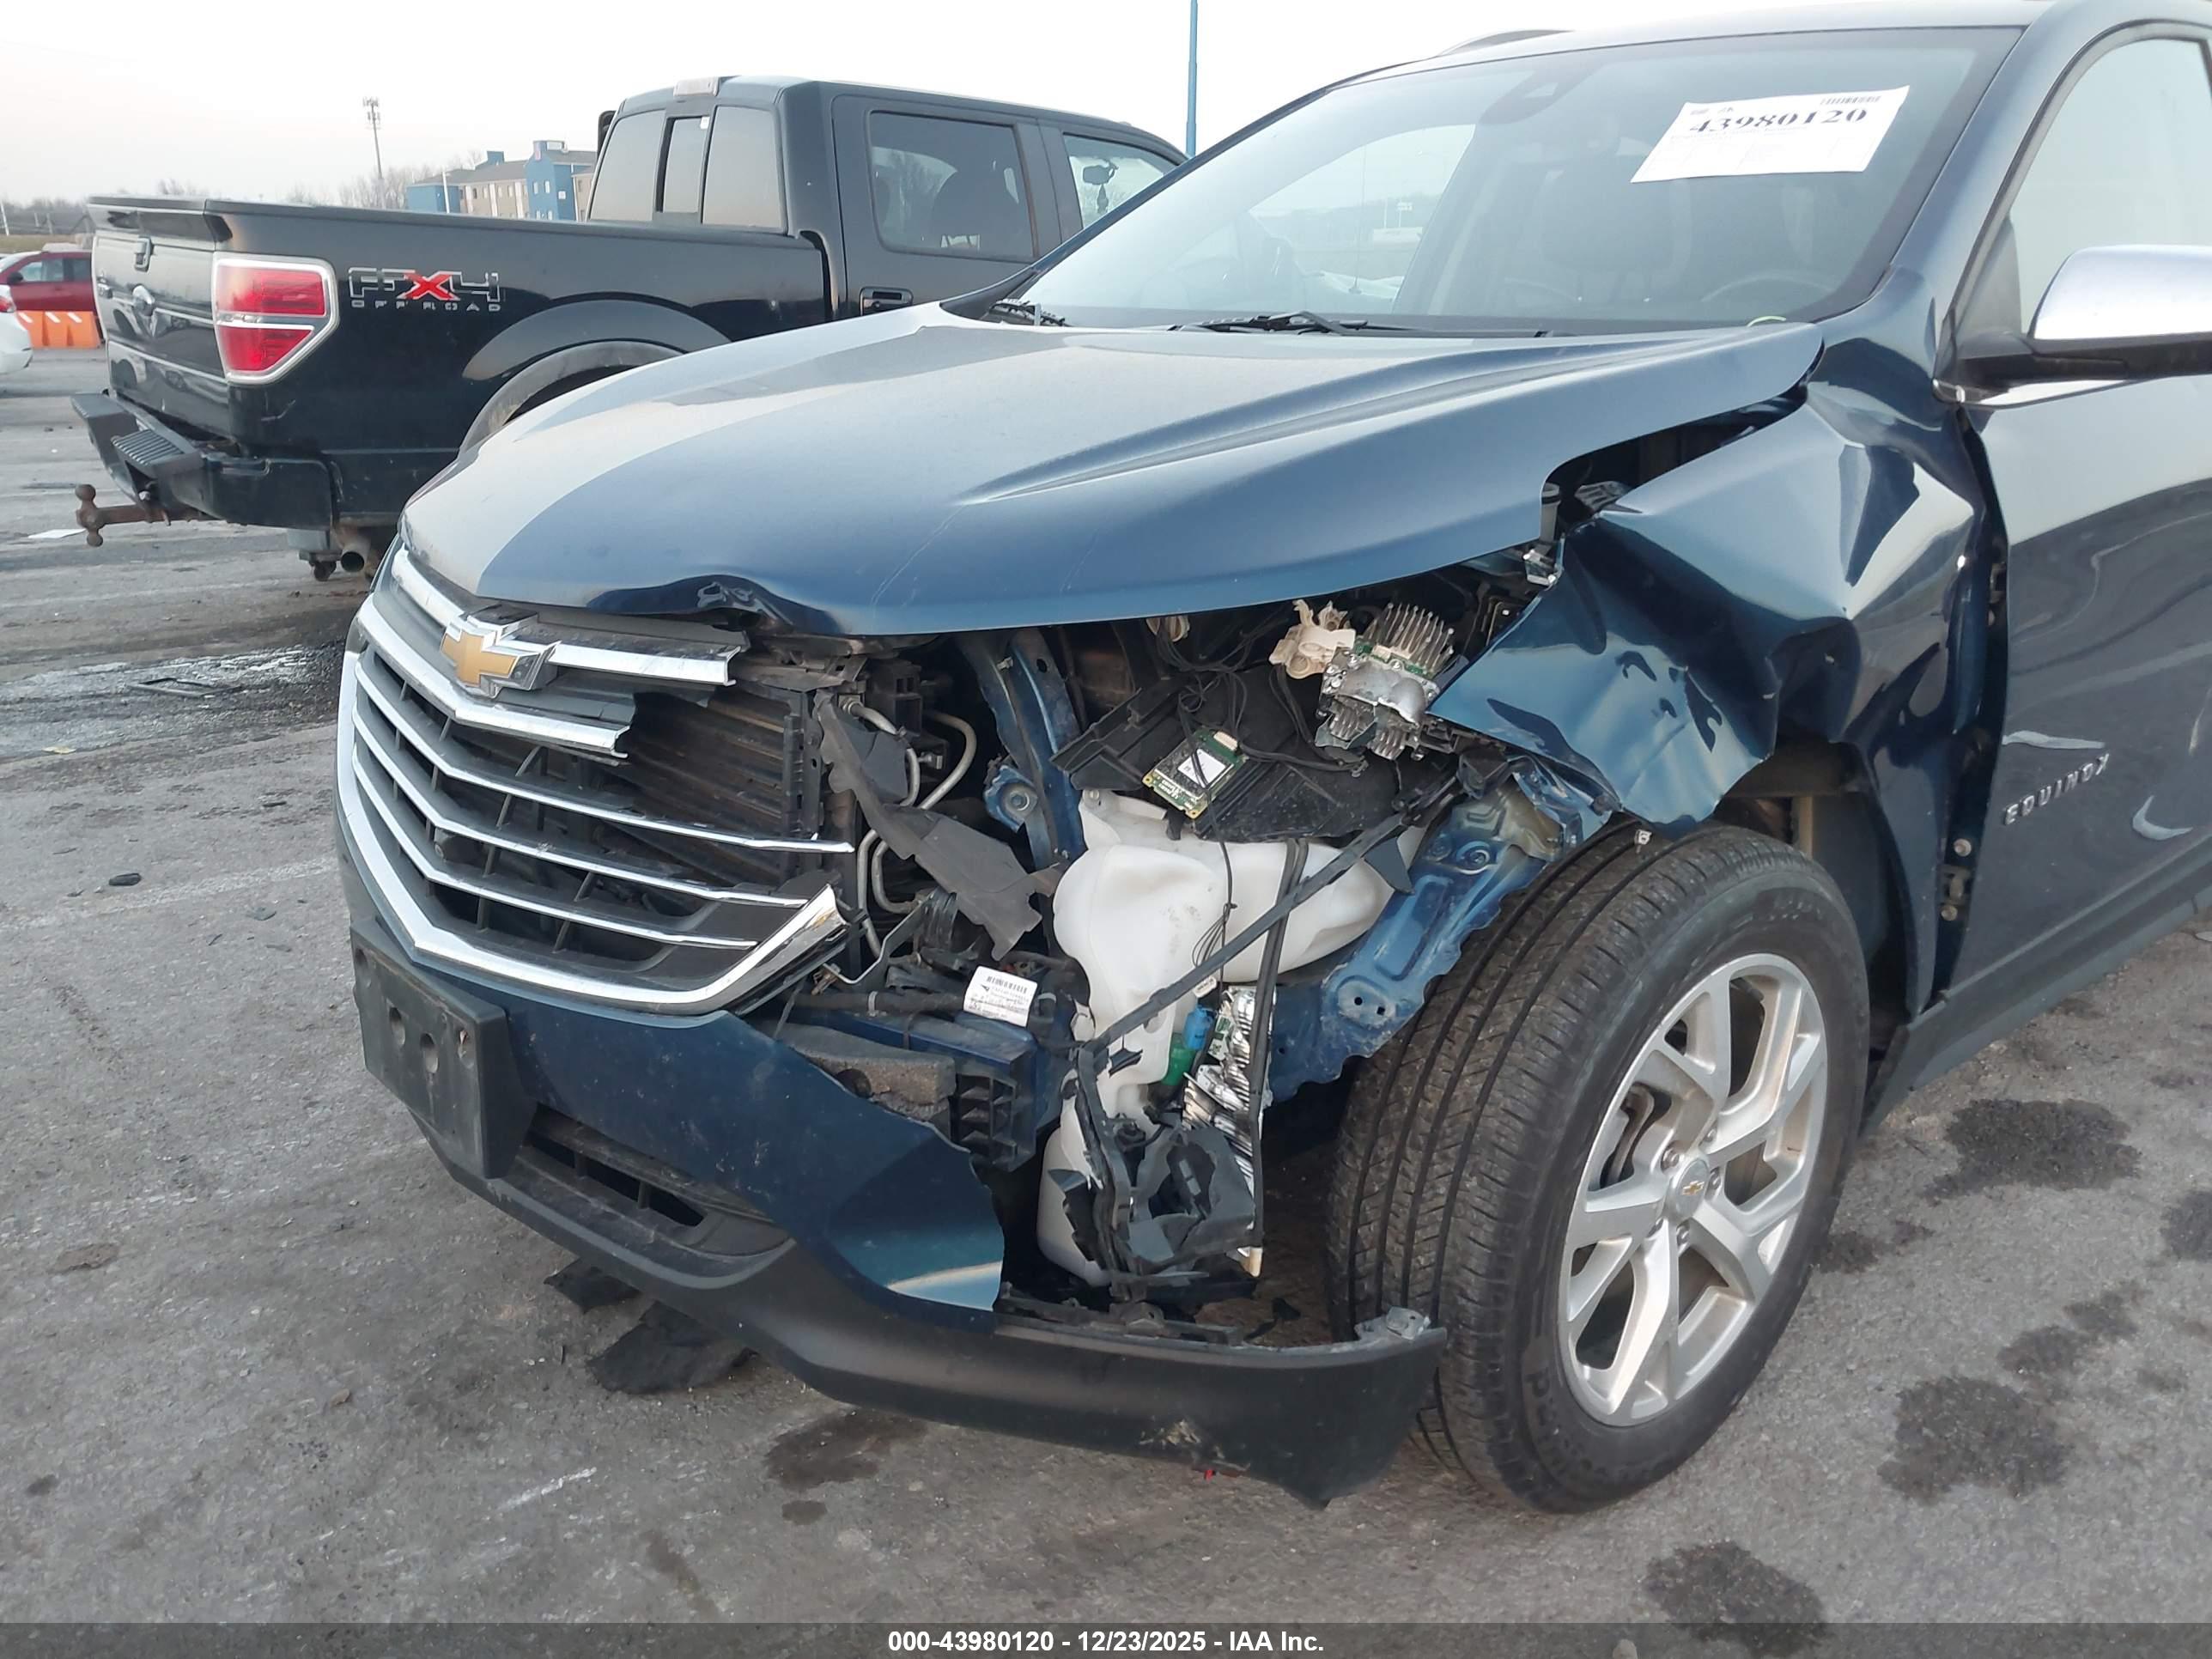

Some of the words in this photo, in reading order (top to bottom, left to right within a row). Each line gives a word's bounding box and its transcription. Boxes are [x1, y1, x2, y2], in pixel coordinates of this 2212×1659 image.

[1689, 108, 1868, 132] 43980120
[348, 267, 501, 302] FX4
[422, 301, 501, 312] ROAD
[2005, 753, 2110, 824] EQUINOX
